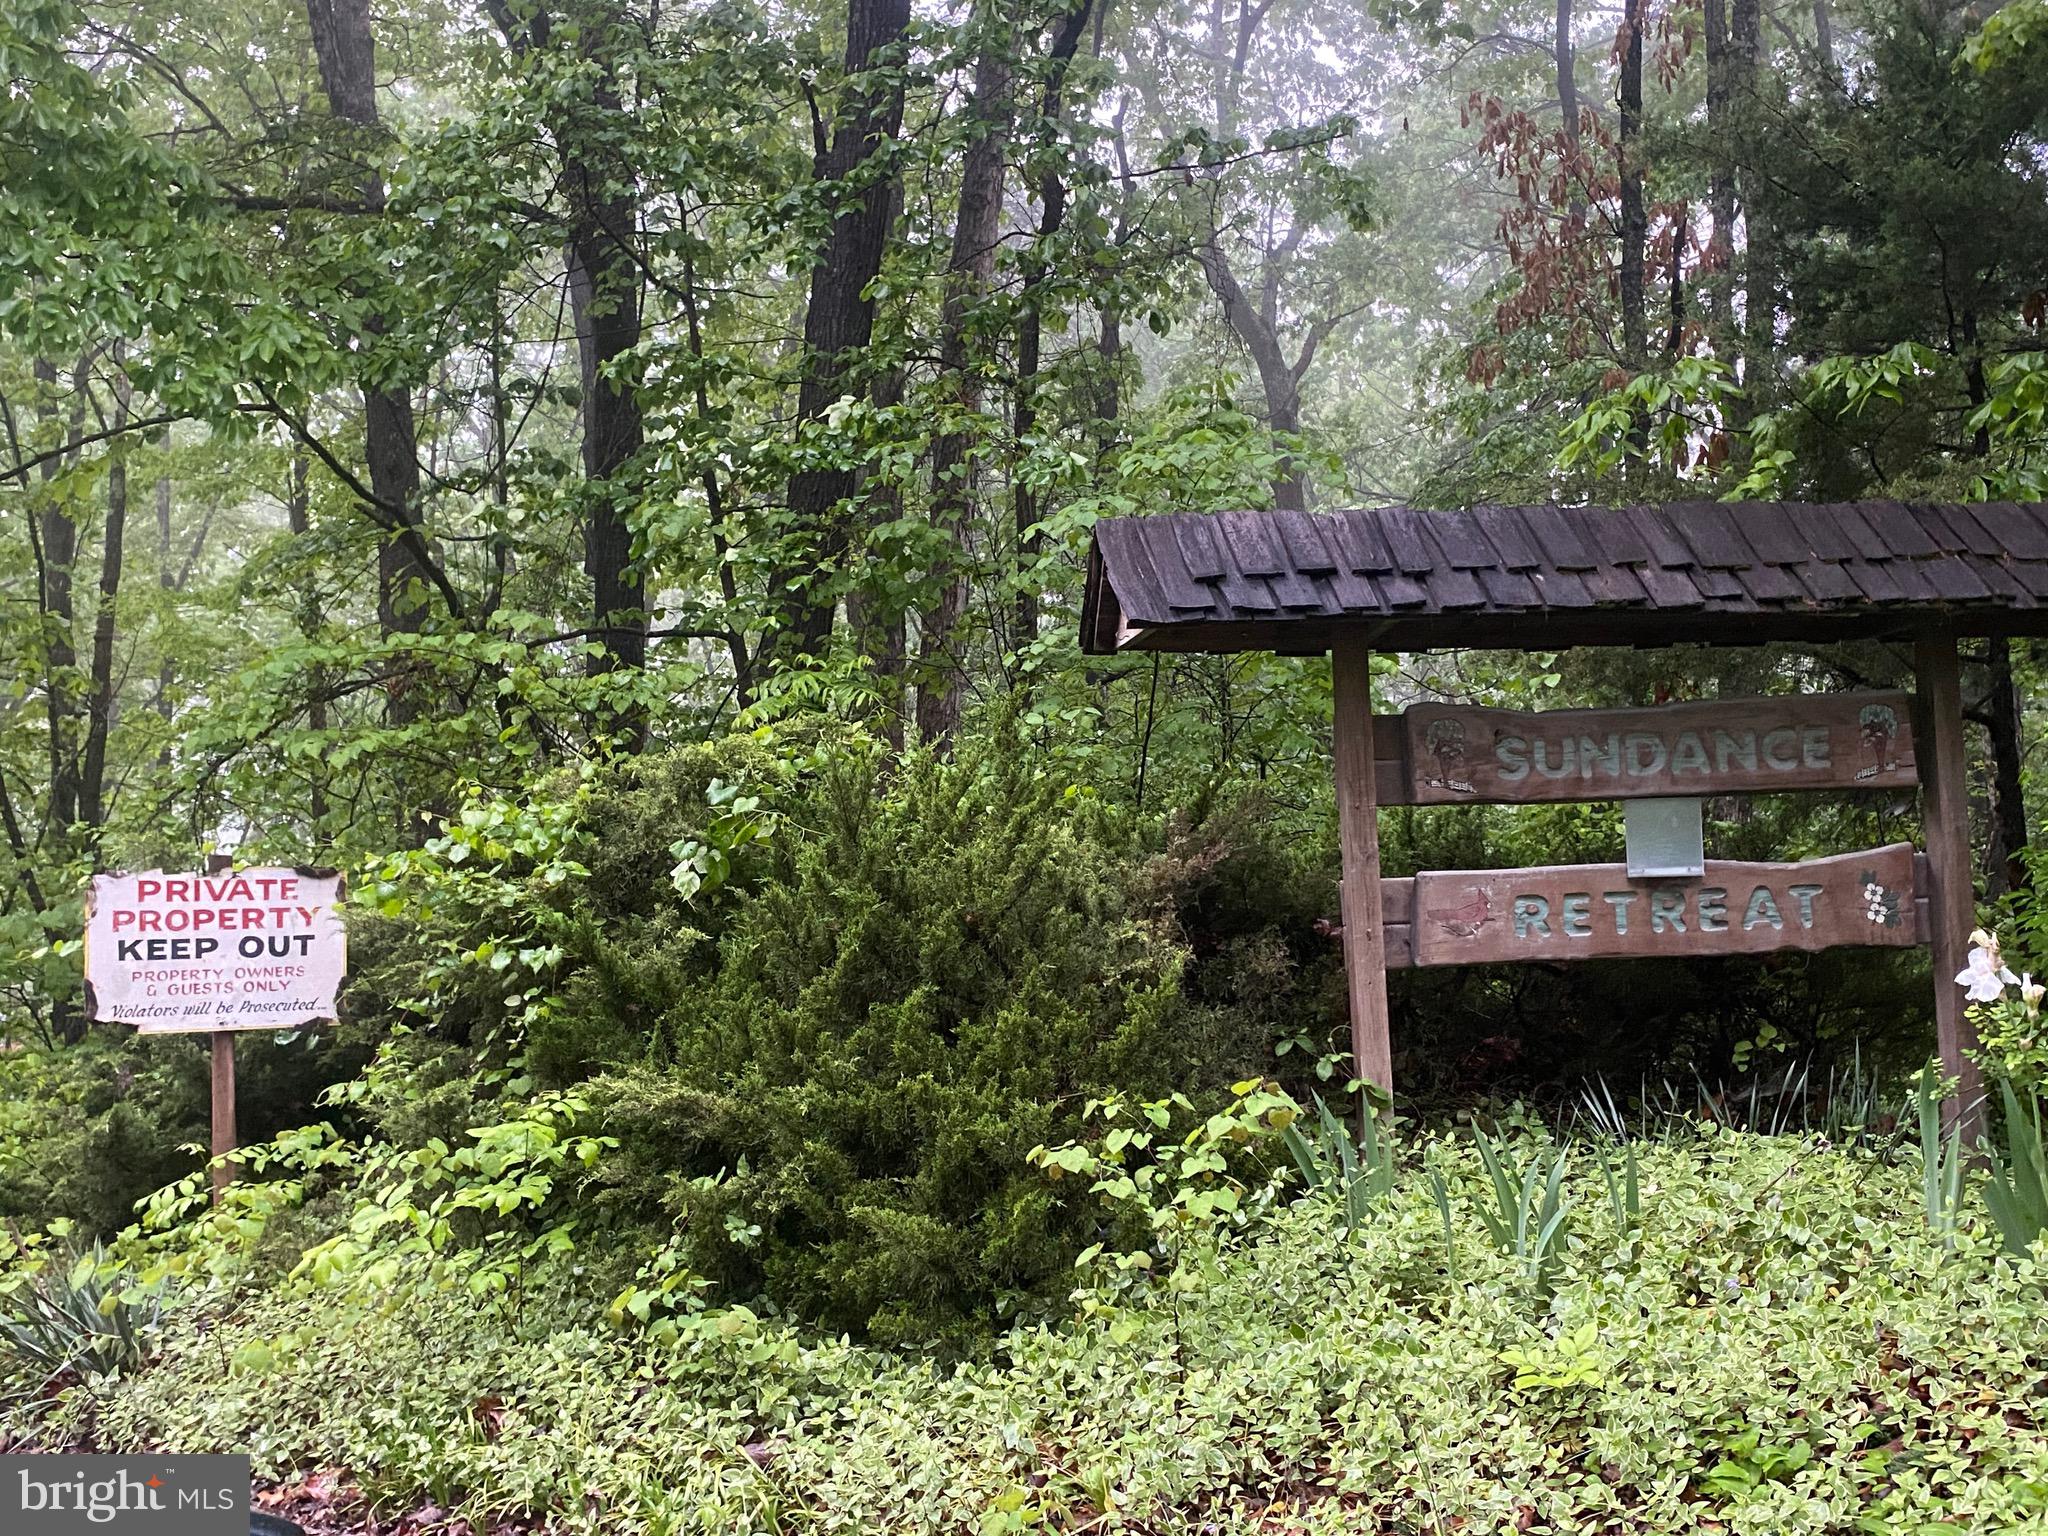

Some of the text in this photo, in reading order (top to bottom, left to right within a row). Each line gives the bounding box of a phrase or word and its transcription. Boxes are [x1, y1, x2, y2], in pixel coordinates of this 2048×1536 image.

[1494, 726, 1832, 781] SUNDANCE
[138, 878, 299, 902] PRIVATE
[112, 906, 321, 932] PROPERTY
[1513, 883, 1824, 938] RETREAT
[118, 935, 315, 961] KEEP OUT
[132, 966, 304, 982] PROPERTY OWNERS
[168, 982, 233, 995] GUESTS
[243, 980, 291, 992] ONLY
[111, 1002, 178, 1018] Violators
[183, 1002, 211, 1015] will
[216, 1001, 233, 1014] be
